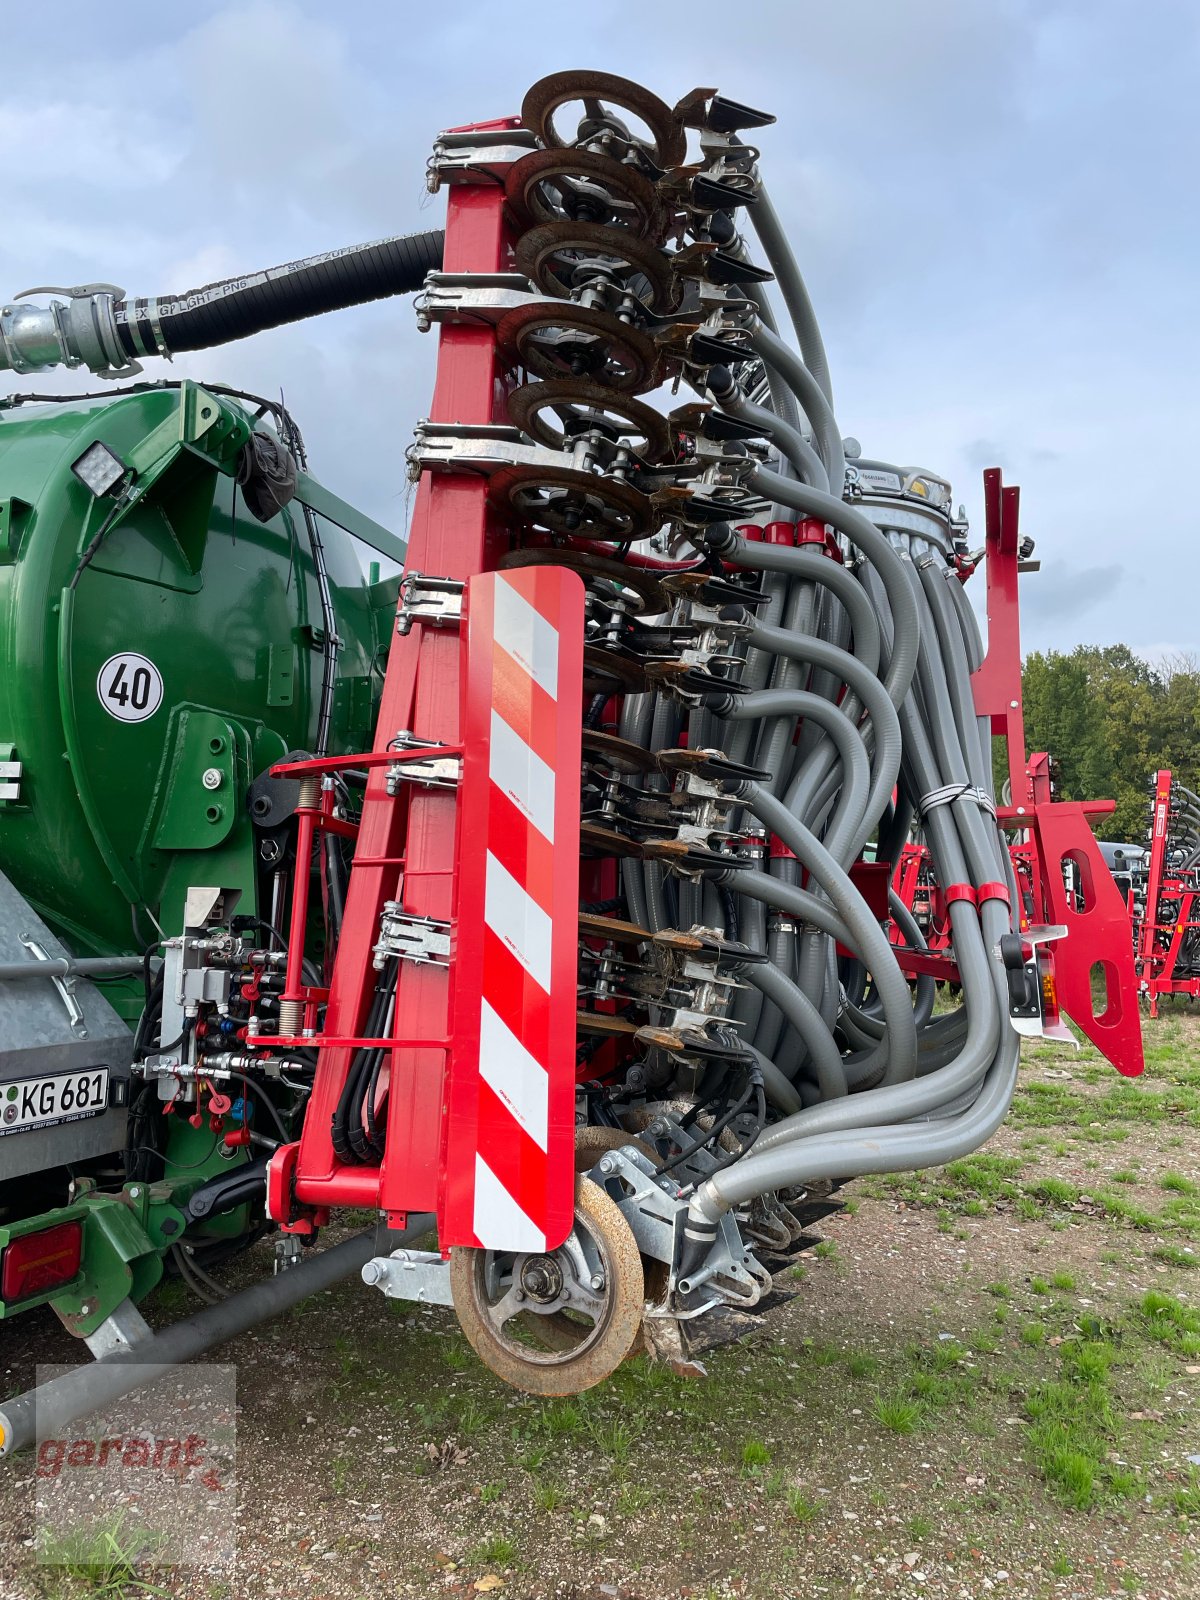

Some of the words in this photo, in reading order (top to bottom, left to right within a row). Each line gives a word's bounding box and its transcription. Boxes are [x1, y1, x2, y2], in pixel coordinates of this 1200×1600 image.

[160, 304, 175, 316] GP
[179, 291, 211, 311] LIGHT
[222, 280, 247, 296] PN6
[108, 663, 151, 710] 40
[22, 1082, 55, 1119] KG
[61, 1074, 103, 1111] 681
